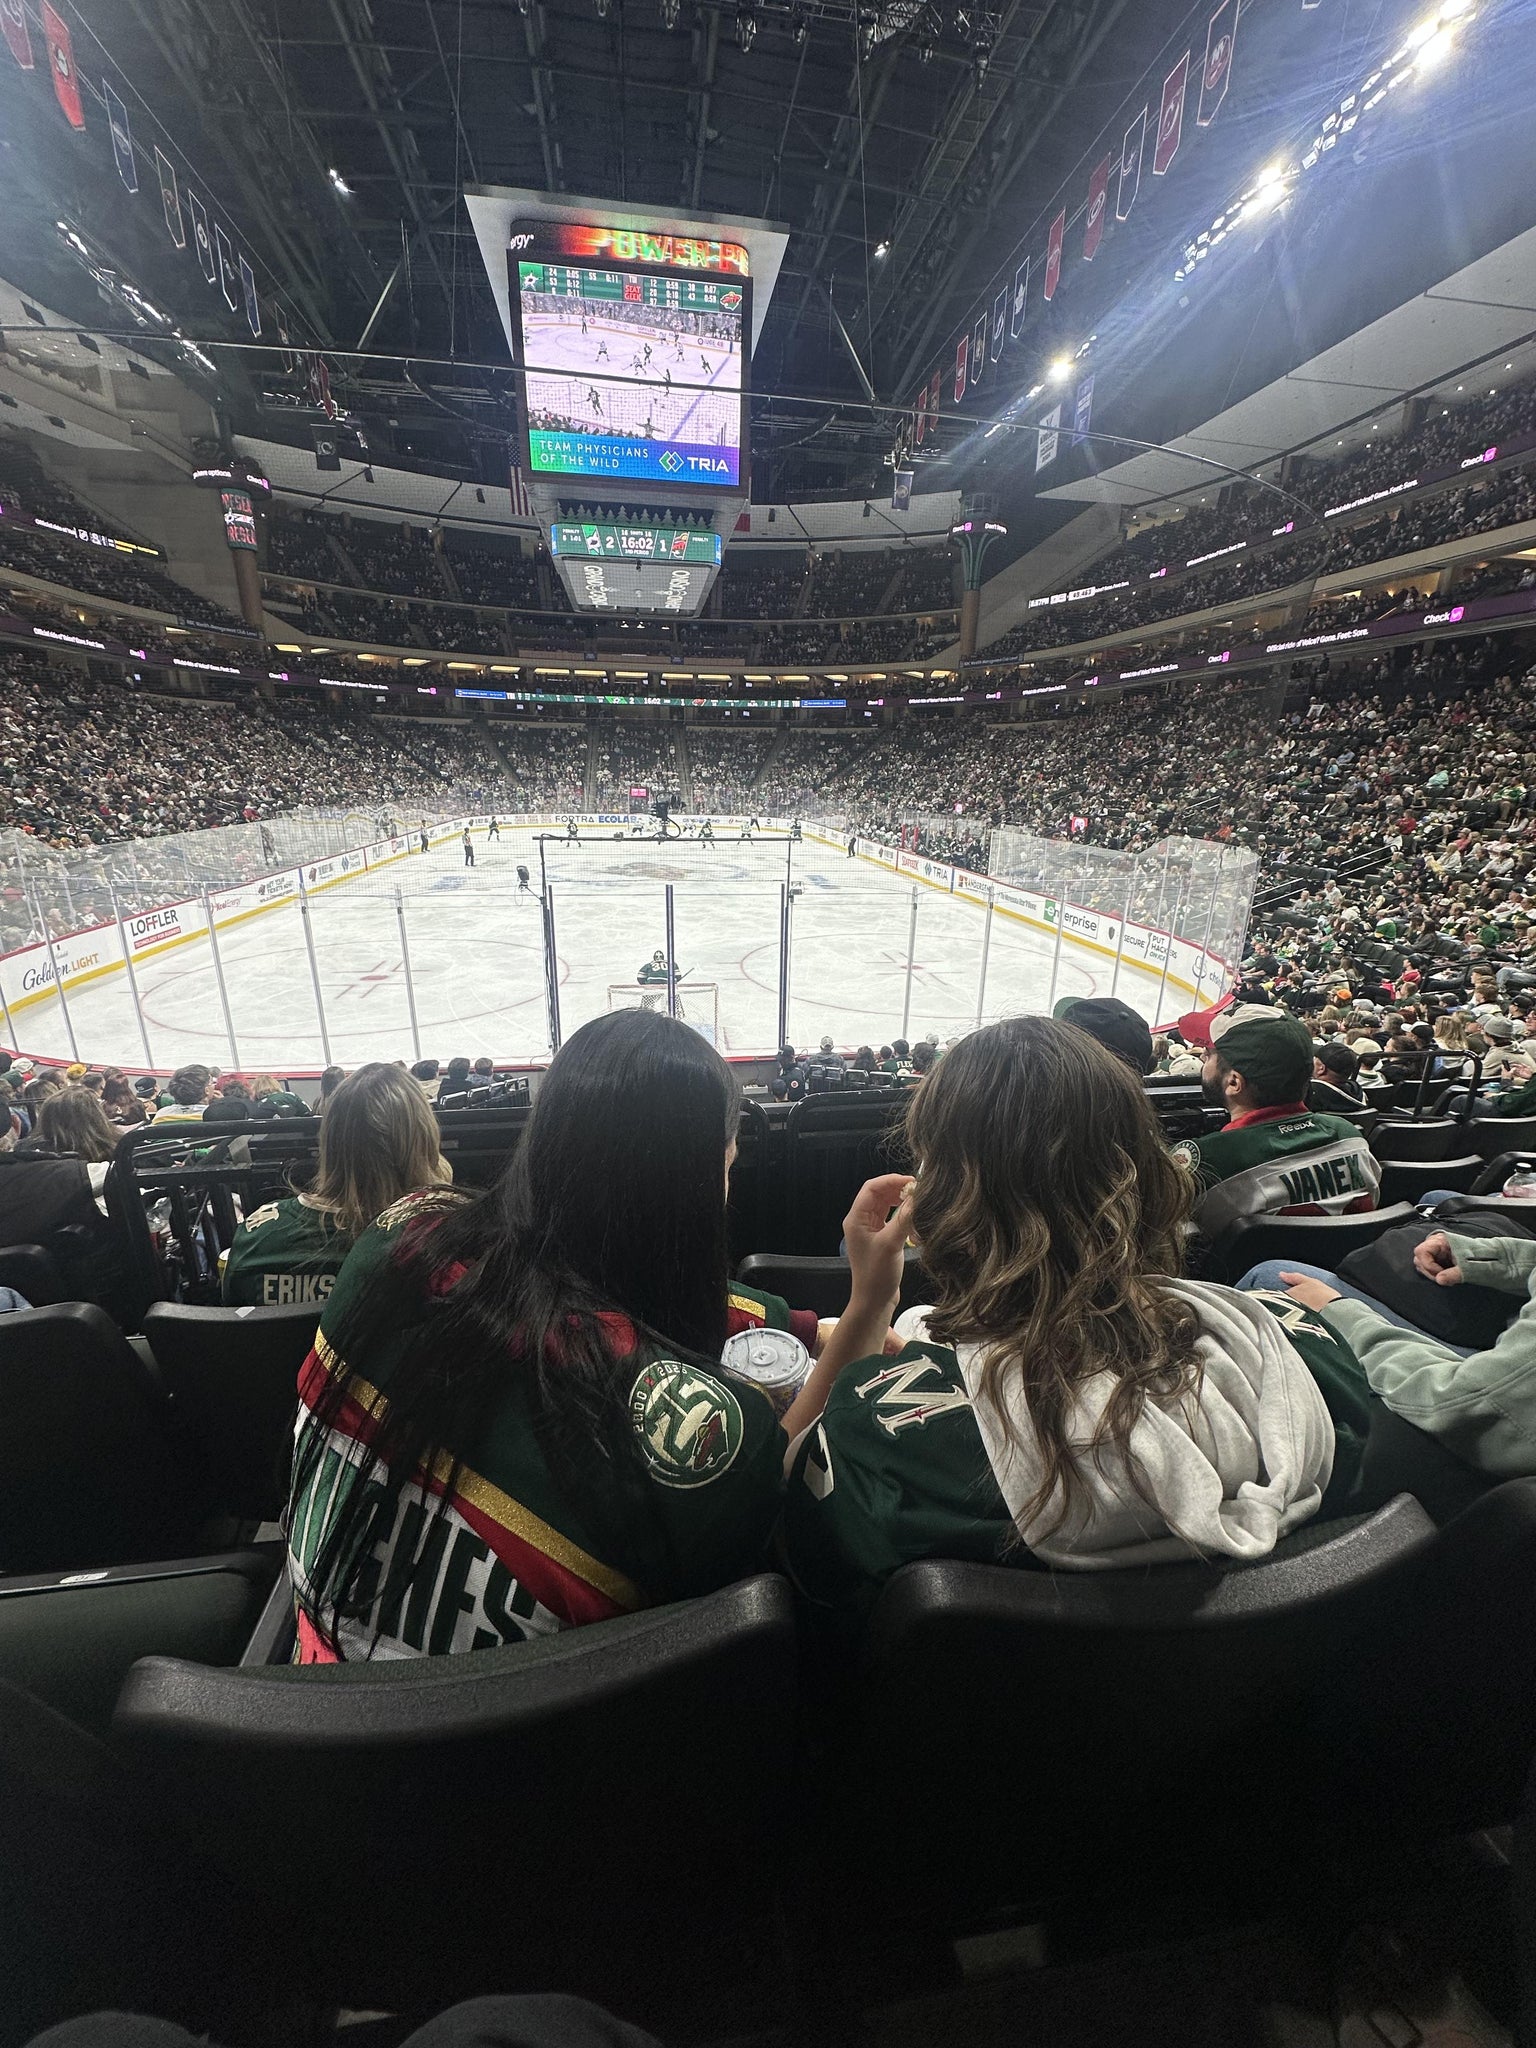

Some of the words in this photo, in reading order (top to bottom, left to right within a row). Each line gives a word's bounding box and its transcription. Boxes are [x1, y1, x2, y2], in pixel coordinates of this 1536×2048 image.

[539, 440, 571, 451] TEAM
[577, 443, 649, 458] PHYSICIANS
[540, 454, 553, 463] OF
[562, 454, 584, 466] THE
[590, 457, 620, 469] WILD
[687, 456, 730, 472] TRIA
[1461, 454, 1484, 468] Check
[605, 536, 614, 549] 2
[621, 536, 653, 550] 16:02
[659, 540, 667, 552] 1
[1424, 612, 1450, 624] Check
[555, 815, 595, 823] FORTRA
[599, 815, 634, 823] ECOLAB
[933, 866, 948, 880] TRIA
[130, 910, 178, 936] LOFFLER
[1046, 906, 1097, 931] enerprise
[1124, 934, 1145, 948] SECURE
[1153, 936, 1165, 945] PUT
[23, 962, 69, 990] Golden
[71, 953, 99, 971] LIGHT
[652, 963, 668, 971] 30
[1278, 1119, 1315, 1134] Reebok
